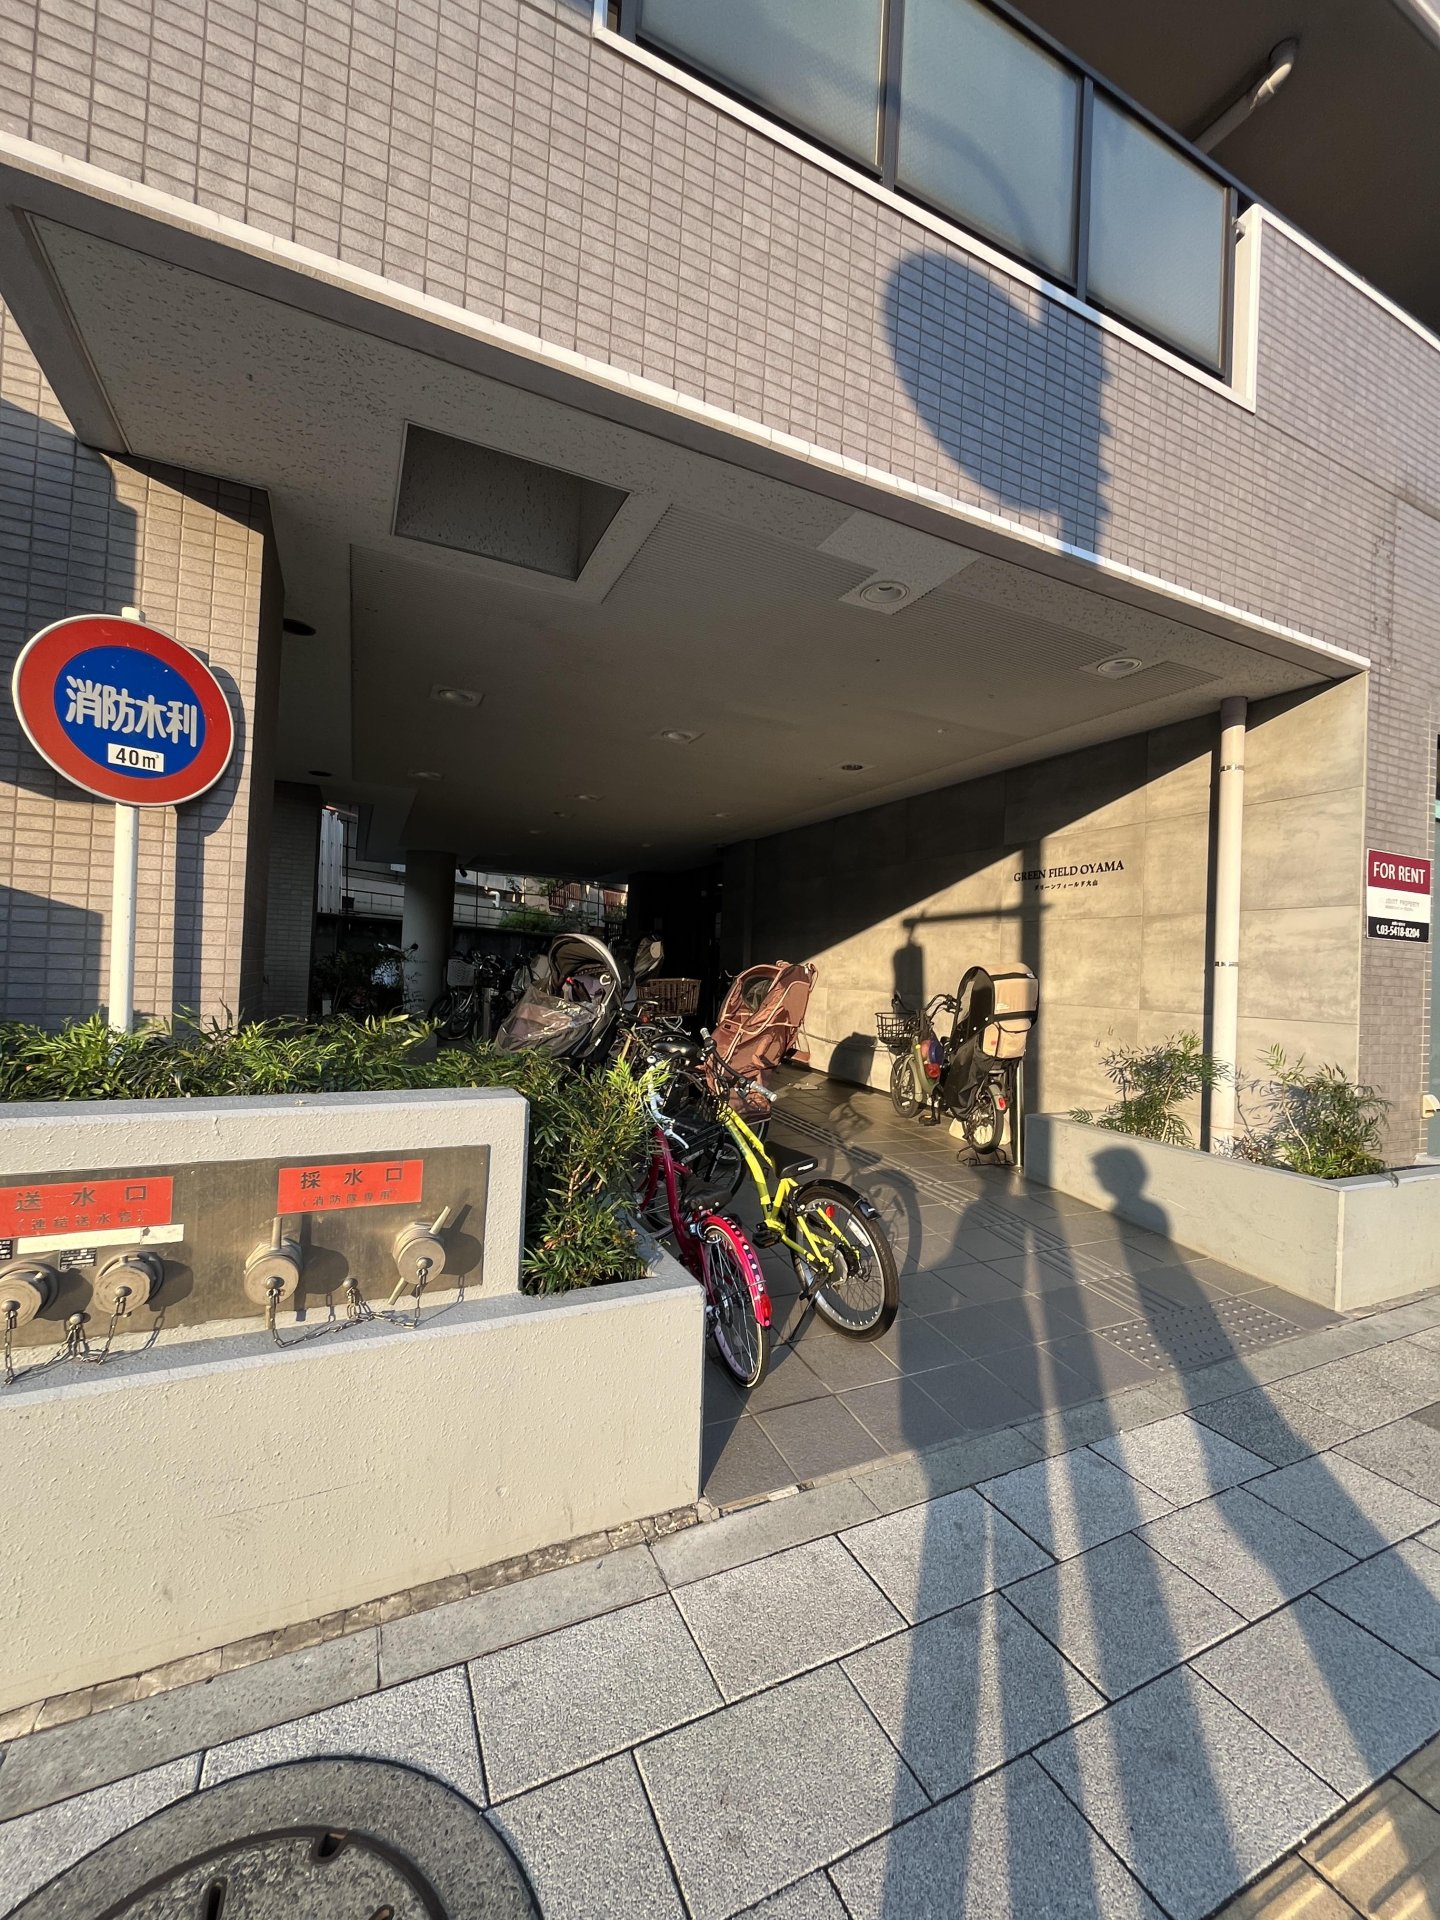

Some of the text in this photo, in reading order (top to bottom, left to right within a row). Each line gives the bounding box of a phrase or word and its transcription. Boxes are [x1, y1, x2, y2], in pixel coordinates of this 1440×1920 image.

[66, 675, 198, 748] 消防水利
[1013, 860, 1125, 882] GREEN FIELD OYAMA
[1373, 861, 1426, 885] FOR RENT
[300, 1167, 403, 1190] 採水口
[15, 1185, 147, 1212] 送水口
